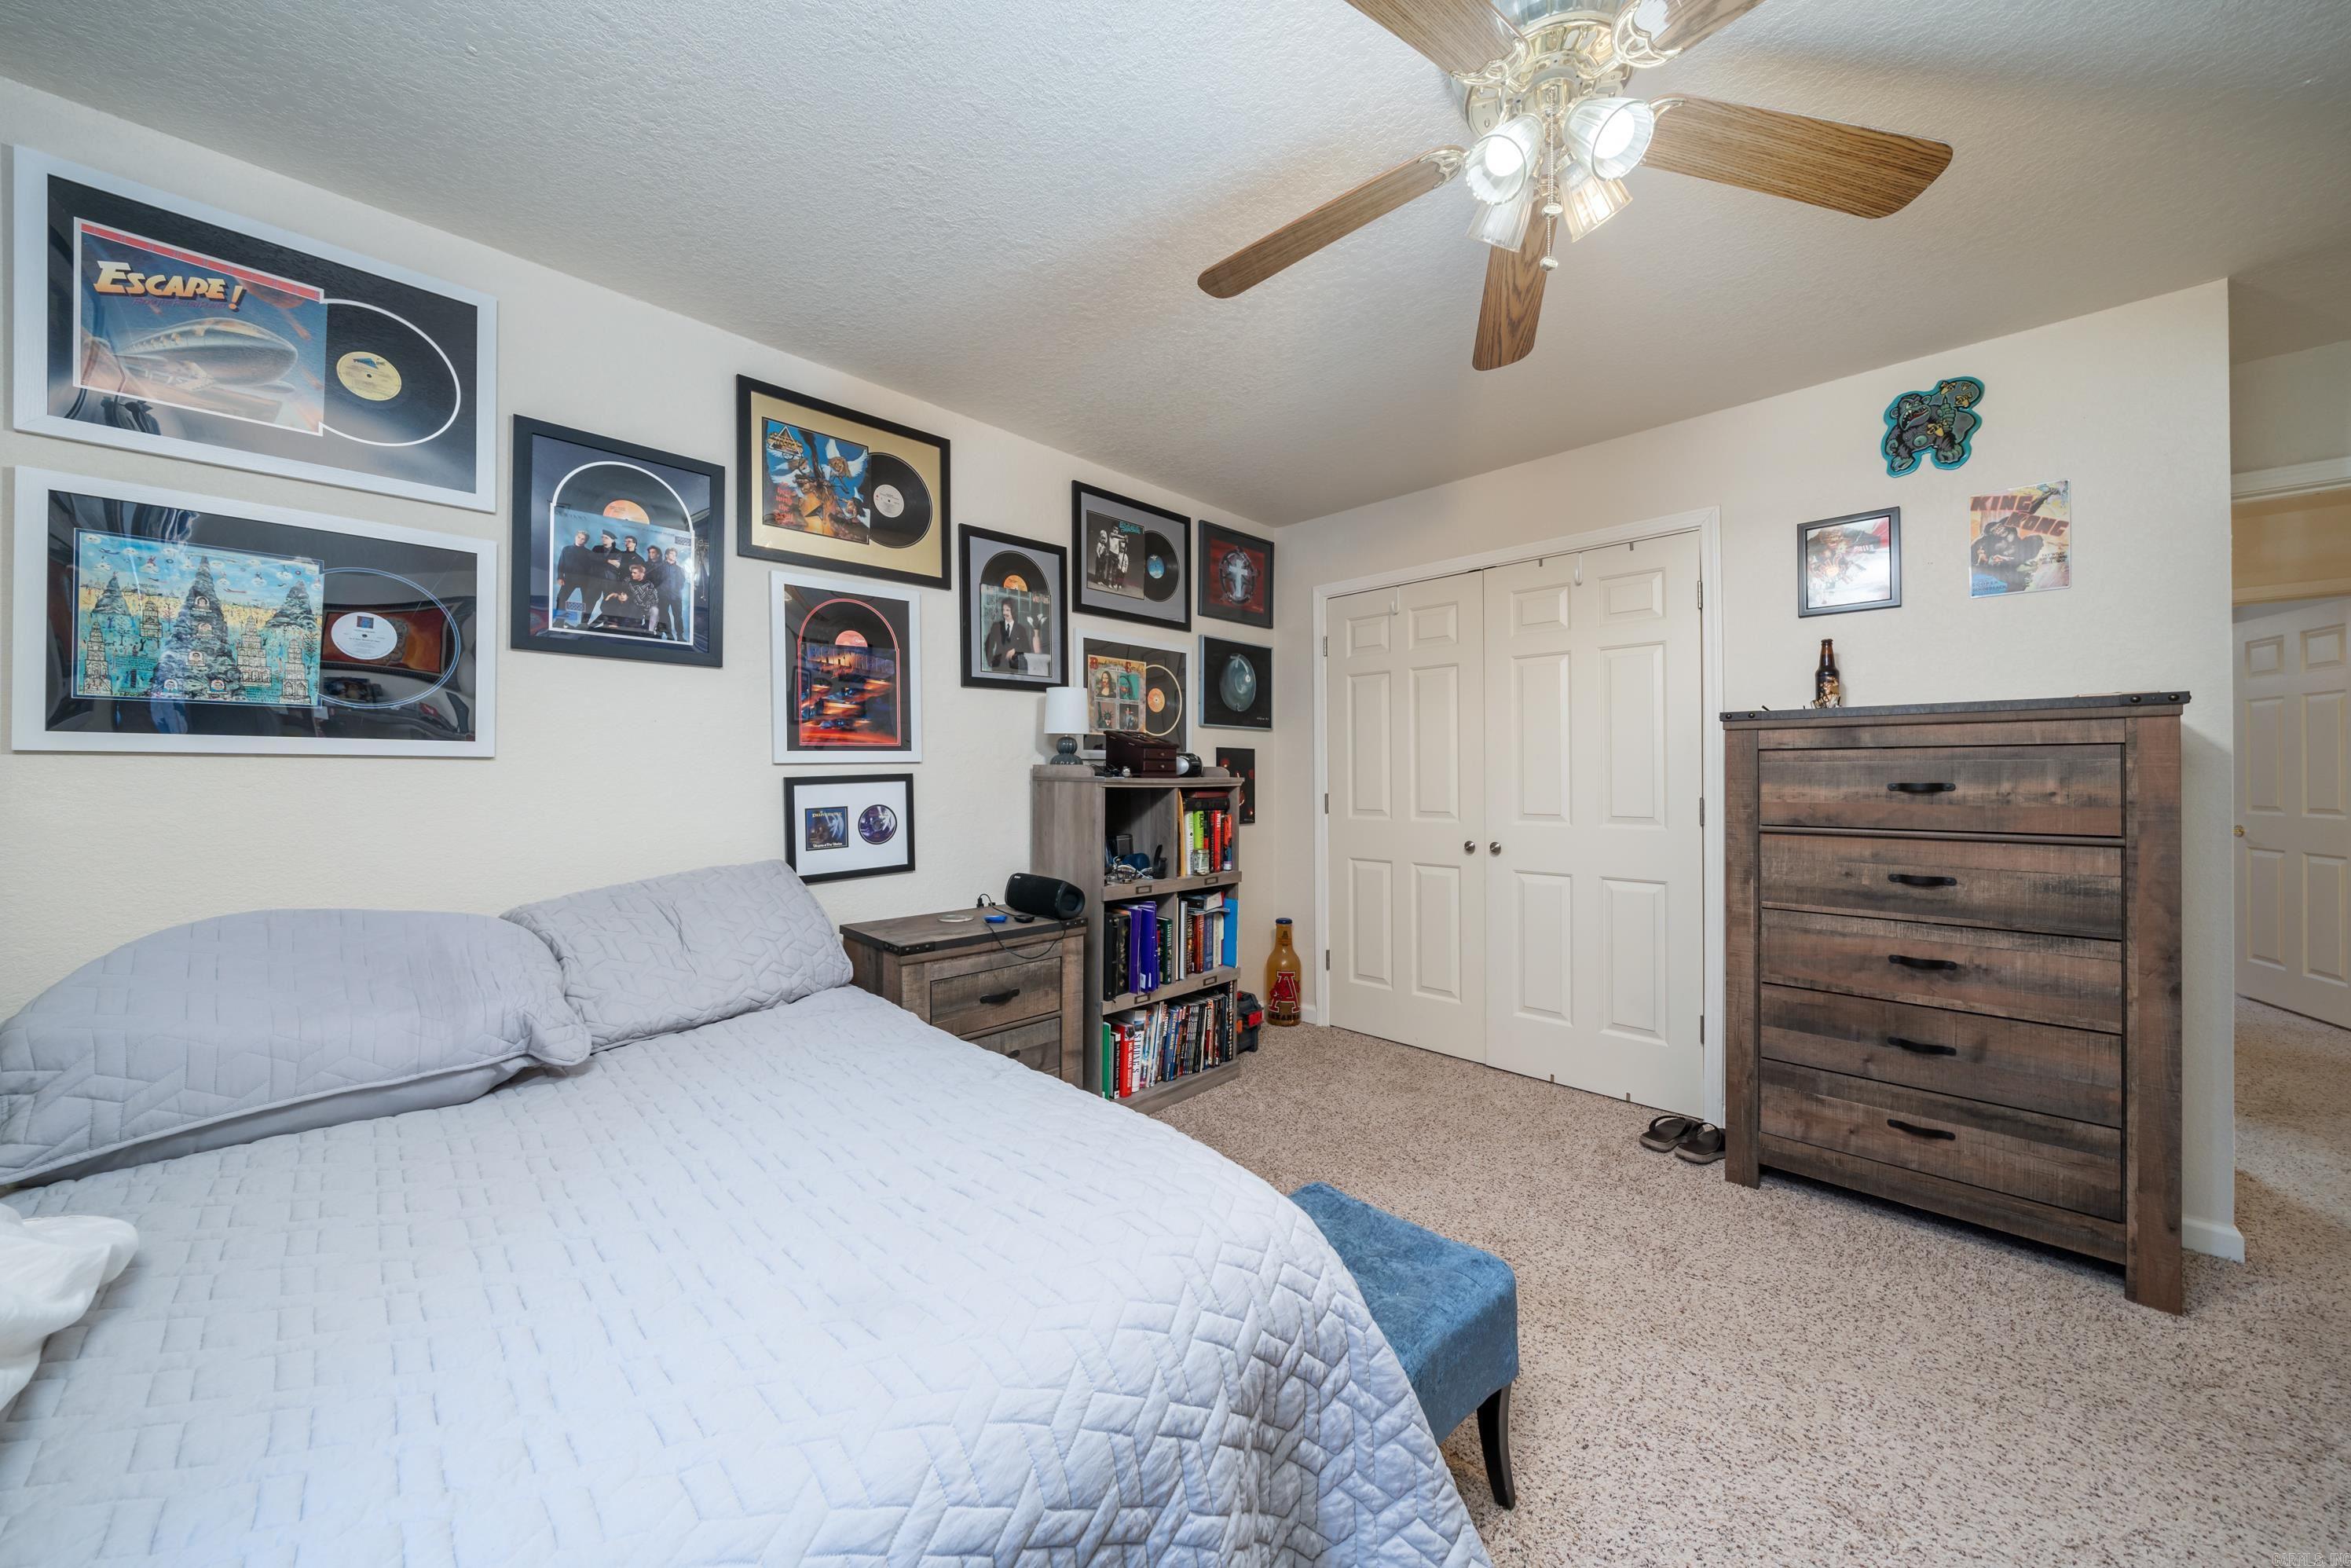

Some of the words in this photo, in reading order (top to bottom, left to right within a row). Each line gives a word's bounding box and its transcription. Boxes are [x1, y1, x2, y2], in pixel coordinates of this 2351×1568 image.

[93, 260, 245, 311] ESCAPE!
[1970, 494, 2034, 511] KING
[2004, 511, 2070, 537] KONG
[1269, 971, 1301, 1013] A
